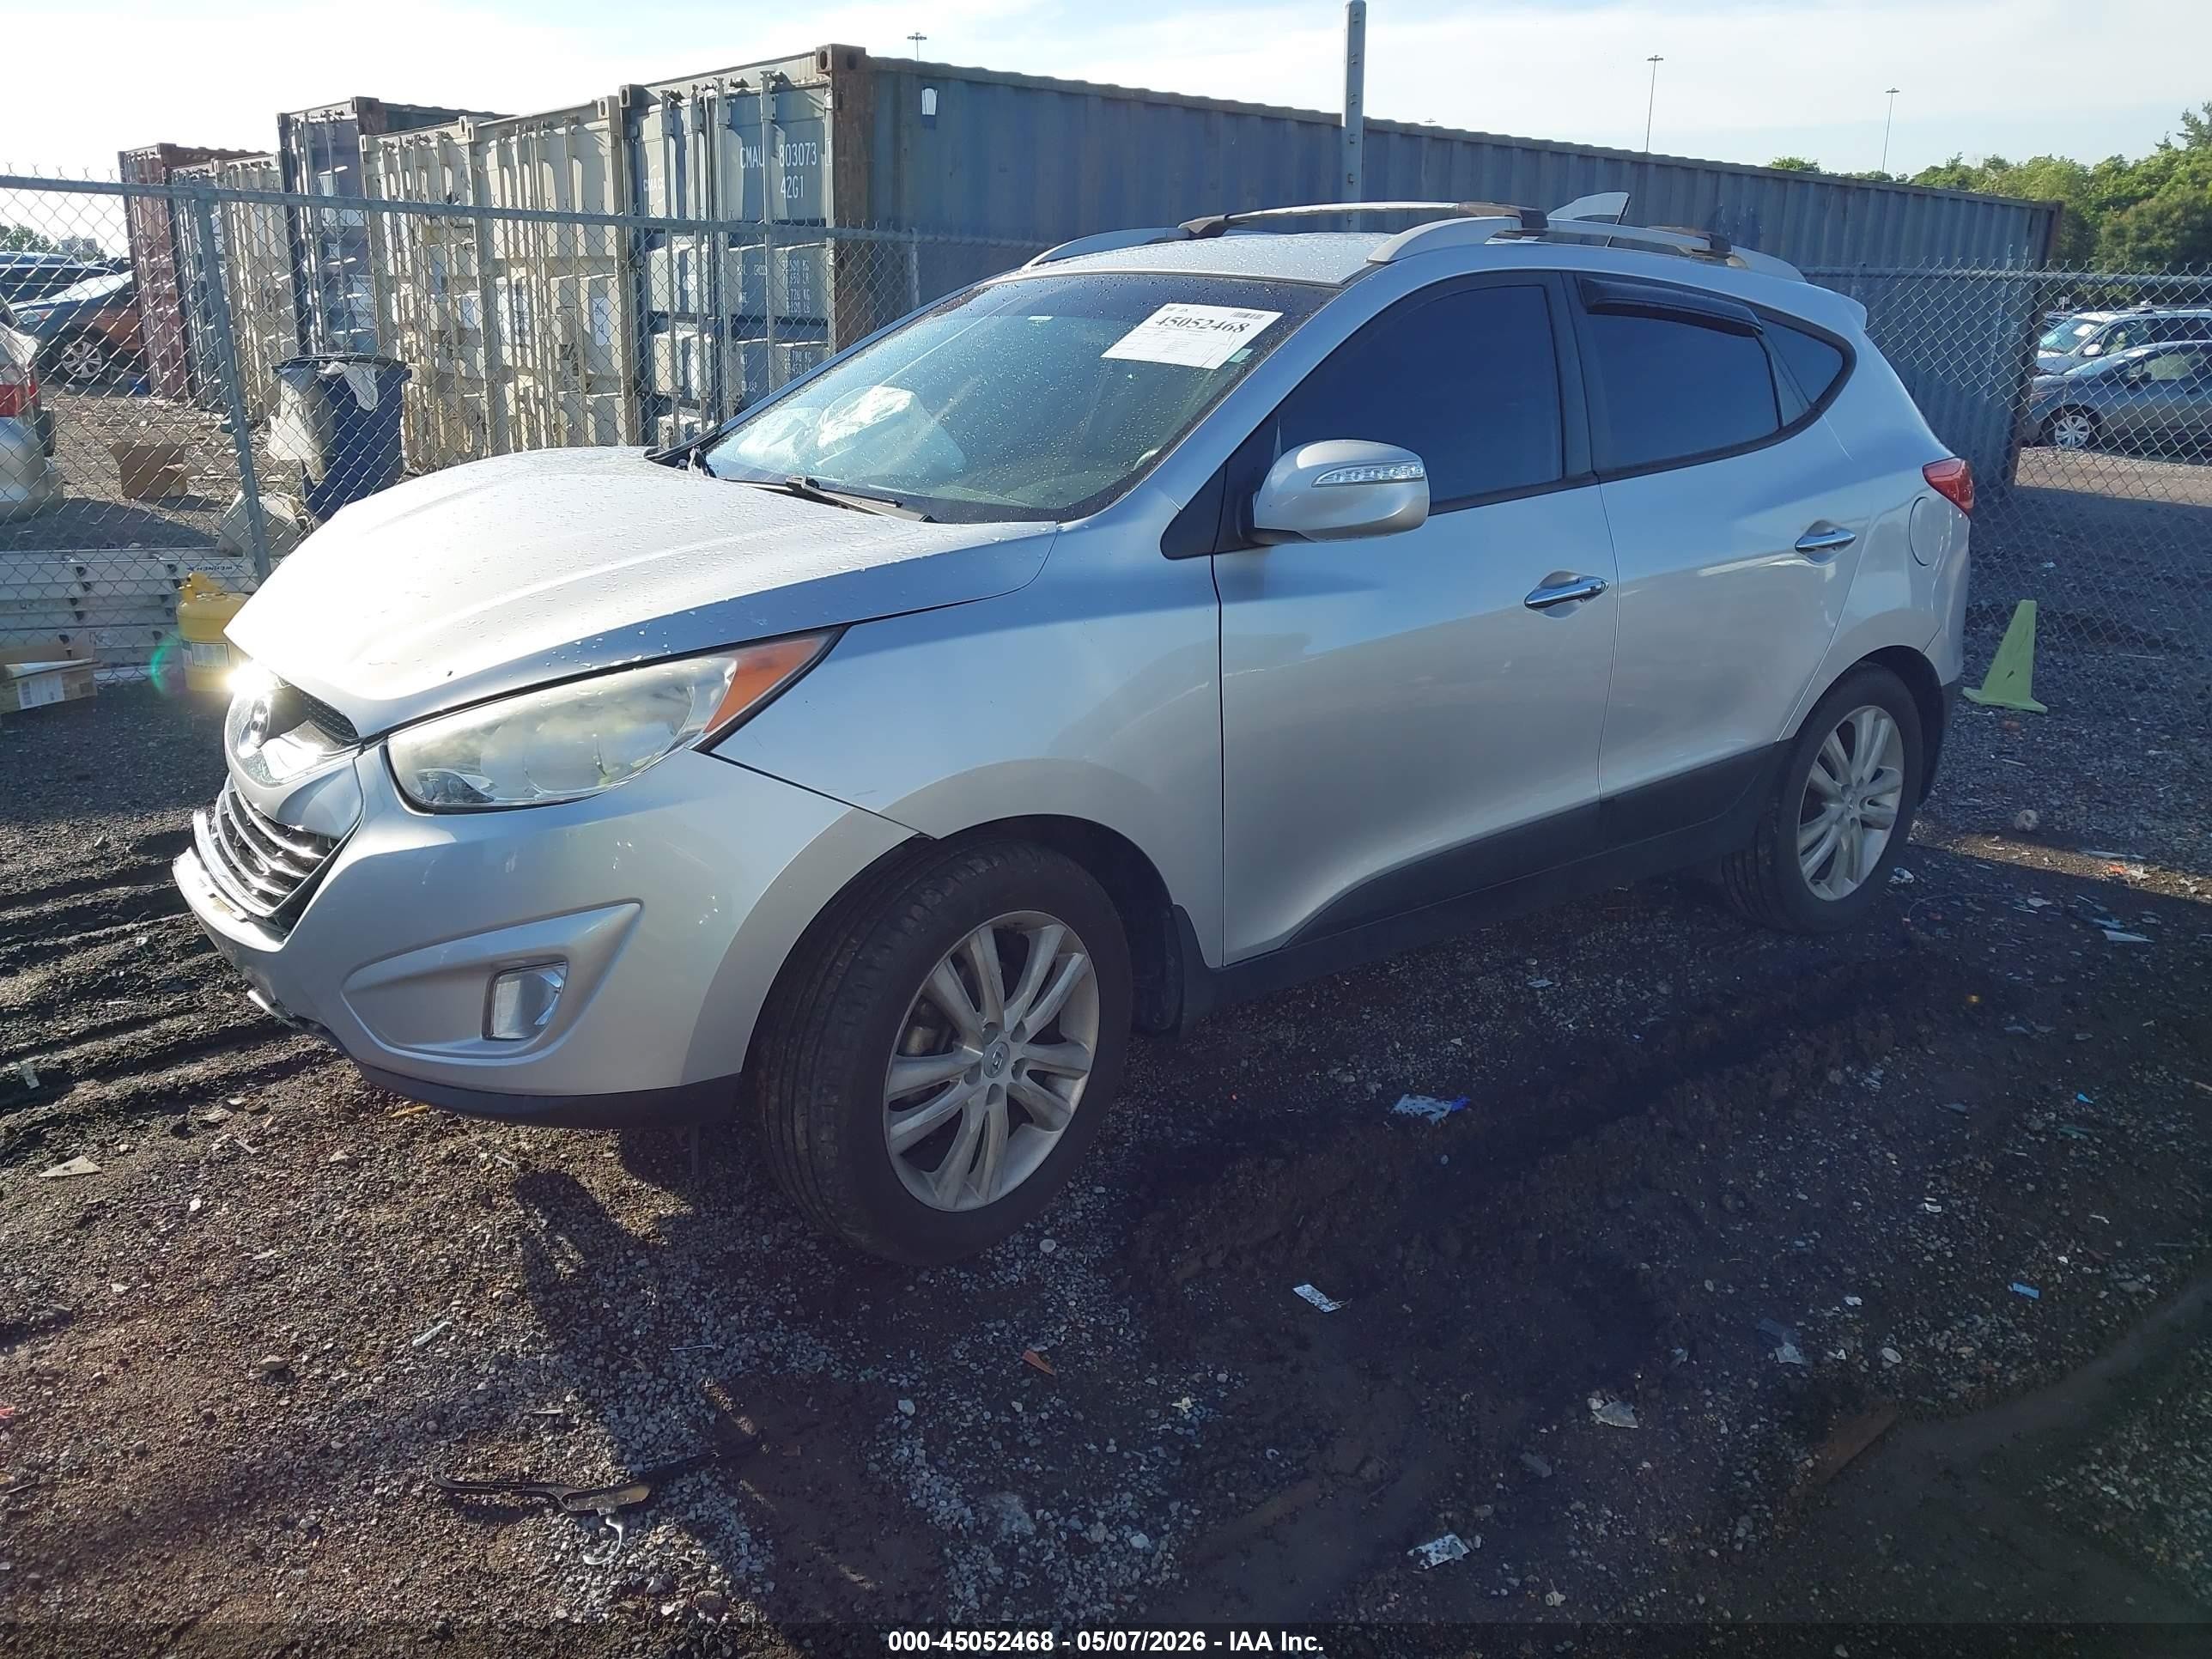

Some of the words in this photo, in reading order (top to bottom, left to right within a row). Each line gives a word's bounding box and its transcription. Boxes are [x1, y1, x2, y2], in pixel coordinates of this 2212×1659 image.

[779, 142, 817, 166] 803073
[781, 175, 804, 198] 42G1
[1156, 317, 1250, 333] 45052468
